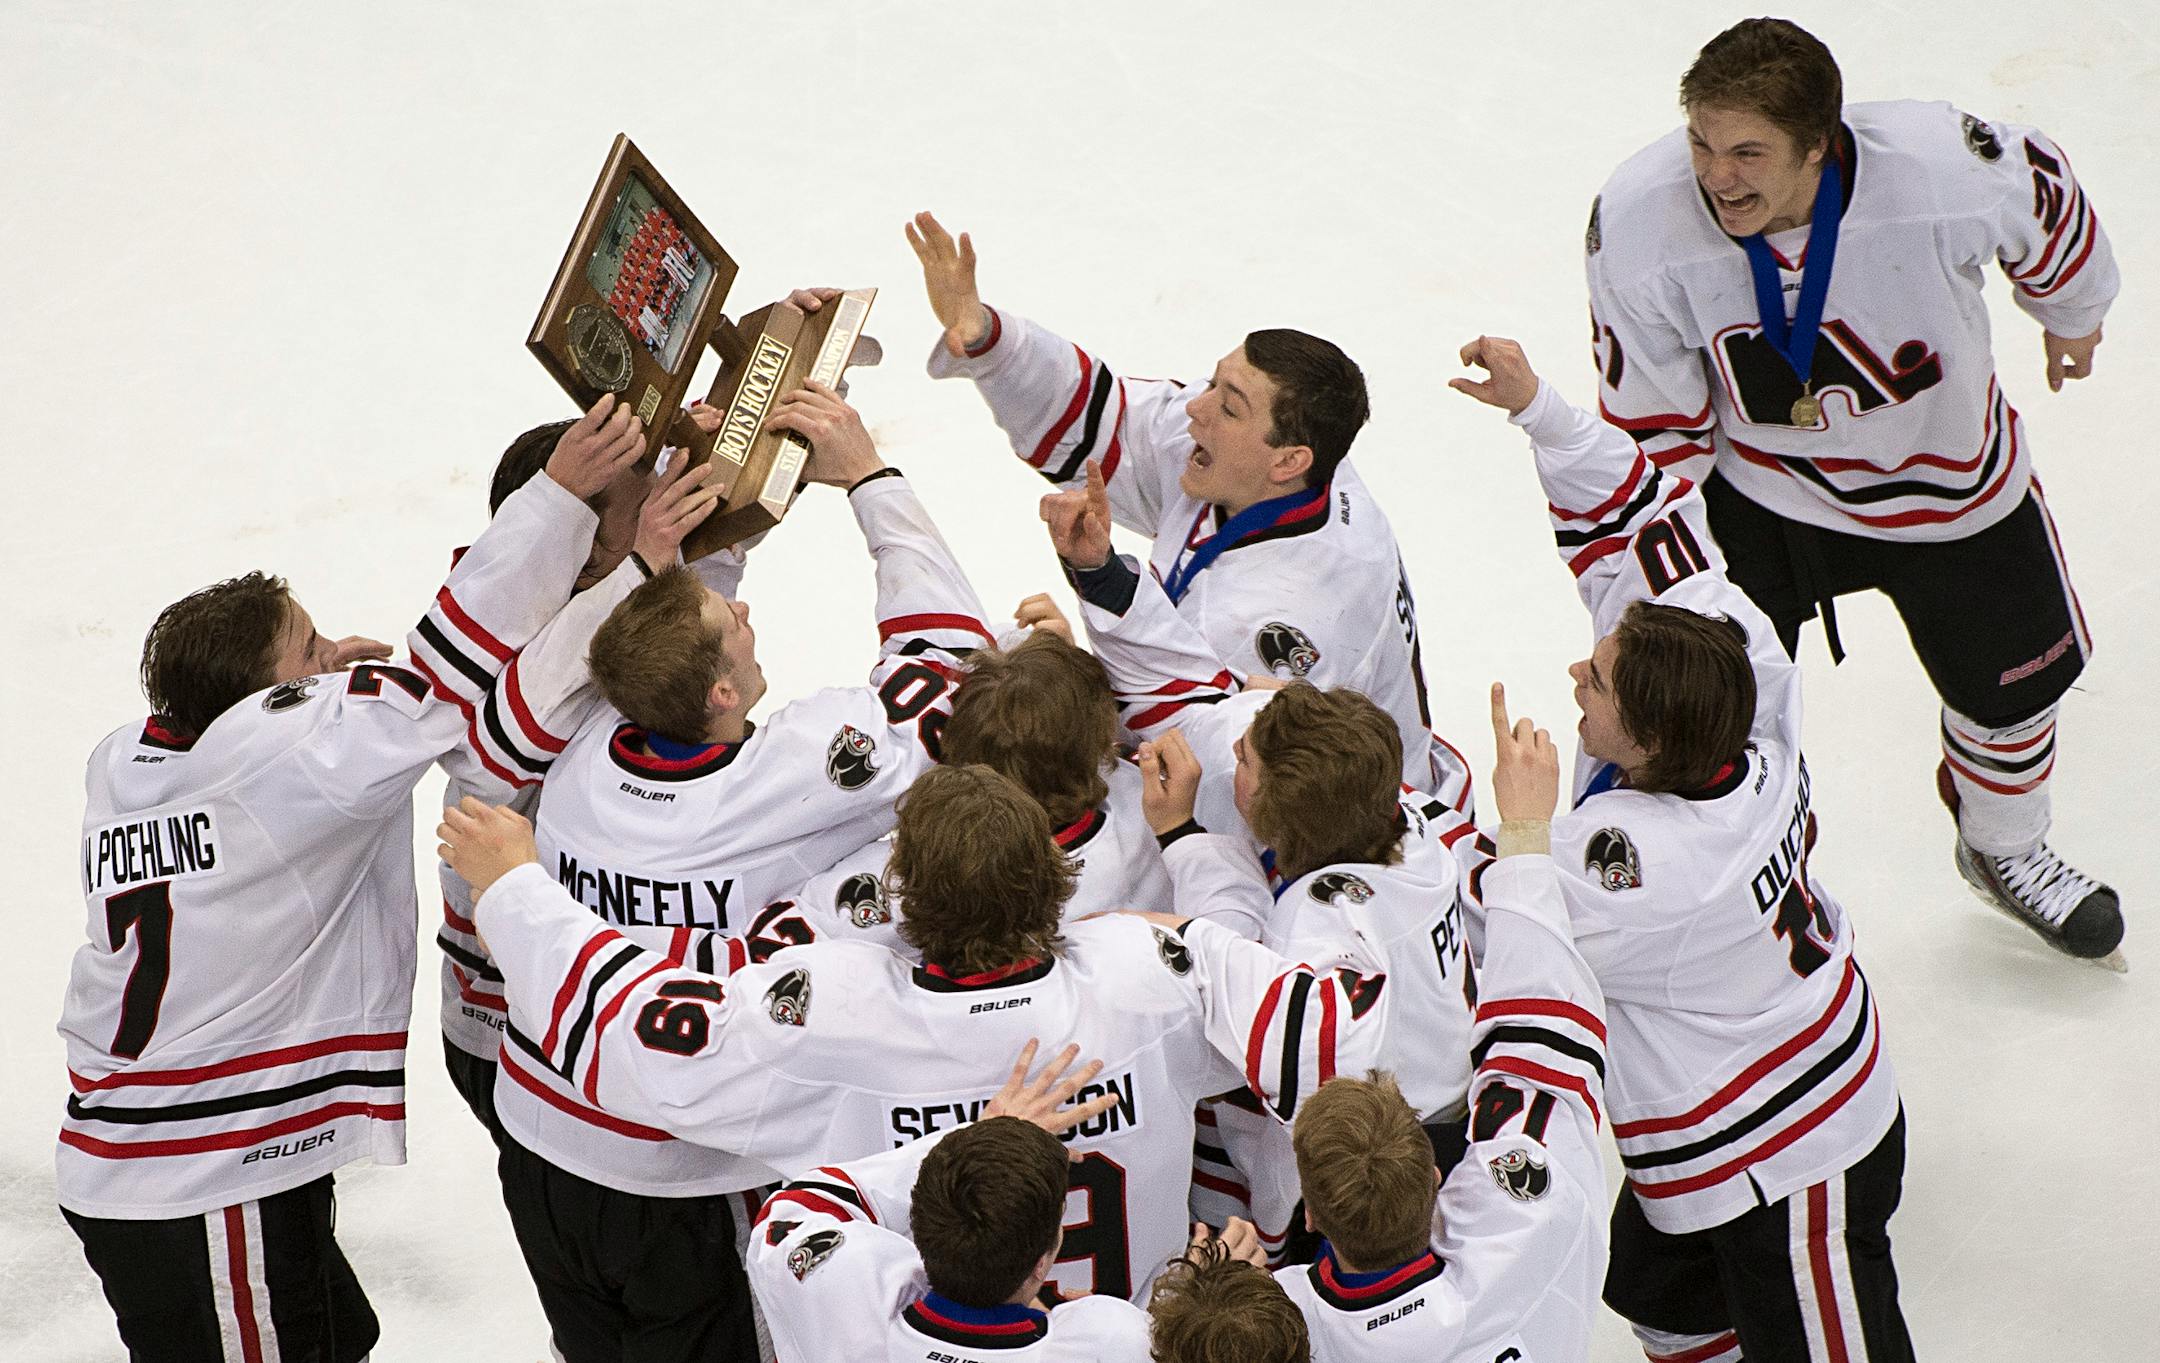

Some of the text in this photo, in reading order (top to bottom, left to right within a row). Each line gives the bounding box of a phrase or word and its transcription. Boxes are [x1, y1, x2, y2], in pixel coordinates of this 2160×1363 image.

[2023, 136, 2064, 236] 21
[718, 337, 787, 462] BOYS HOCKEY
[1634, 510, 1711, 597] 10
[347, 664, 433, 704] 7
[132, 755, 166, 764] BAUER
[1754, 754, 1768, 795] BAUER
[619, 782, 676, 803] BAUER
[95, 811, 217, 888] POEHLING
[105, 880, 174, 1061] 7
[634, 979, 726, 1057] 19
[969, 996, 1031, 1014] BAUER
[242, 1129, 336, 1165] BAUER
[1366, 1298, 1425, 1331] BAUER
